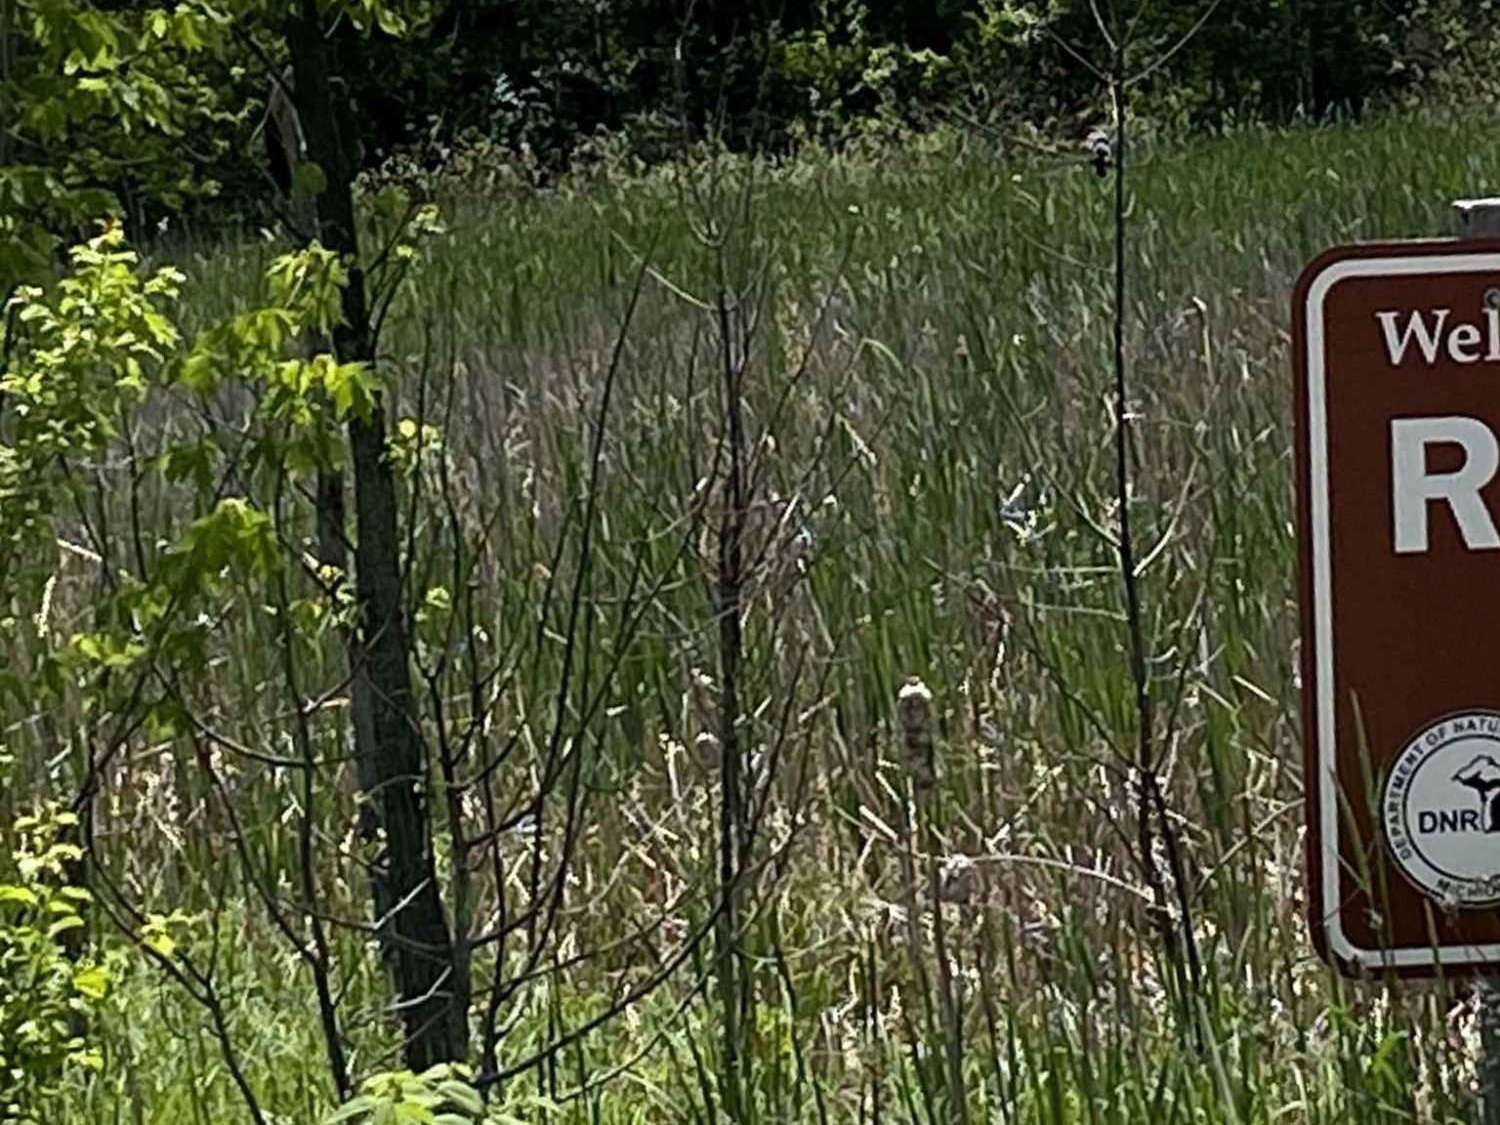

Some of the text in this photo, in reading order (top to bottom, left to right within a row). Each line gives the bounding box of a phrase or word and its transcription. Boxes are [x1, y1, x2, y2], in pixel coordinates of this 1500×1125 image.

[1387, 744, 1425, 861] DEPARTMENT
[1425, 729, 1449, 746] OF
[1418, 809, 1479, 834] DNR
